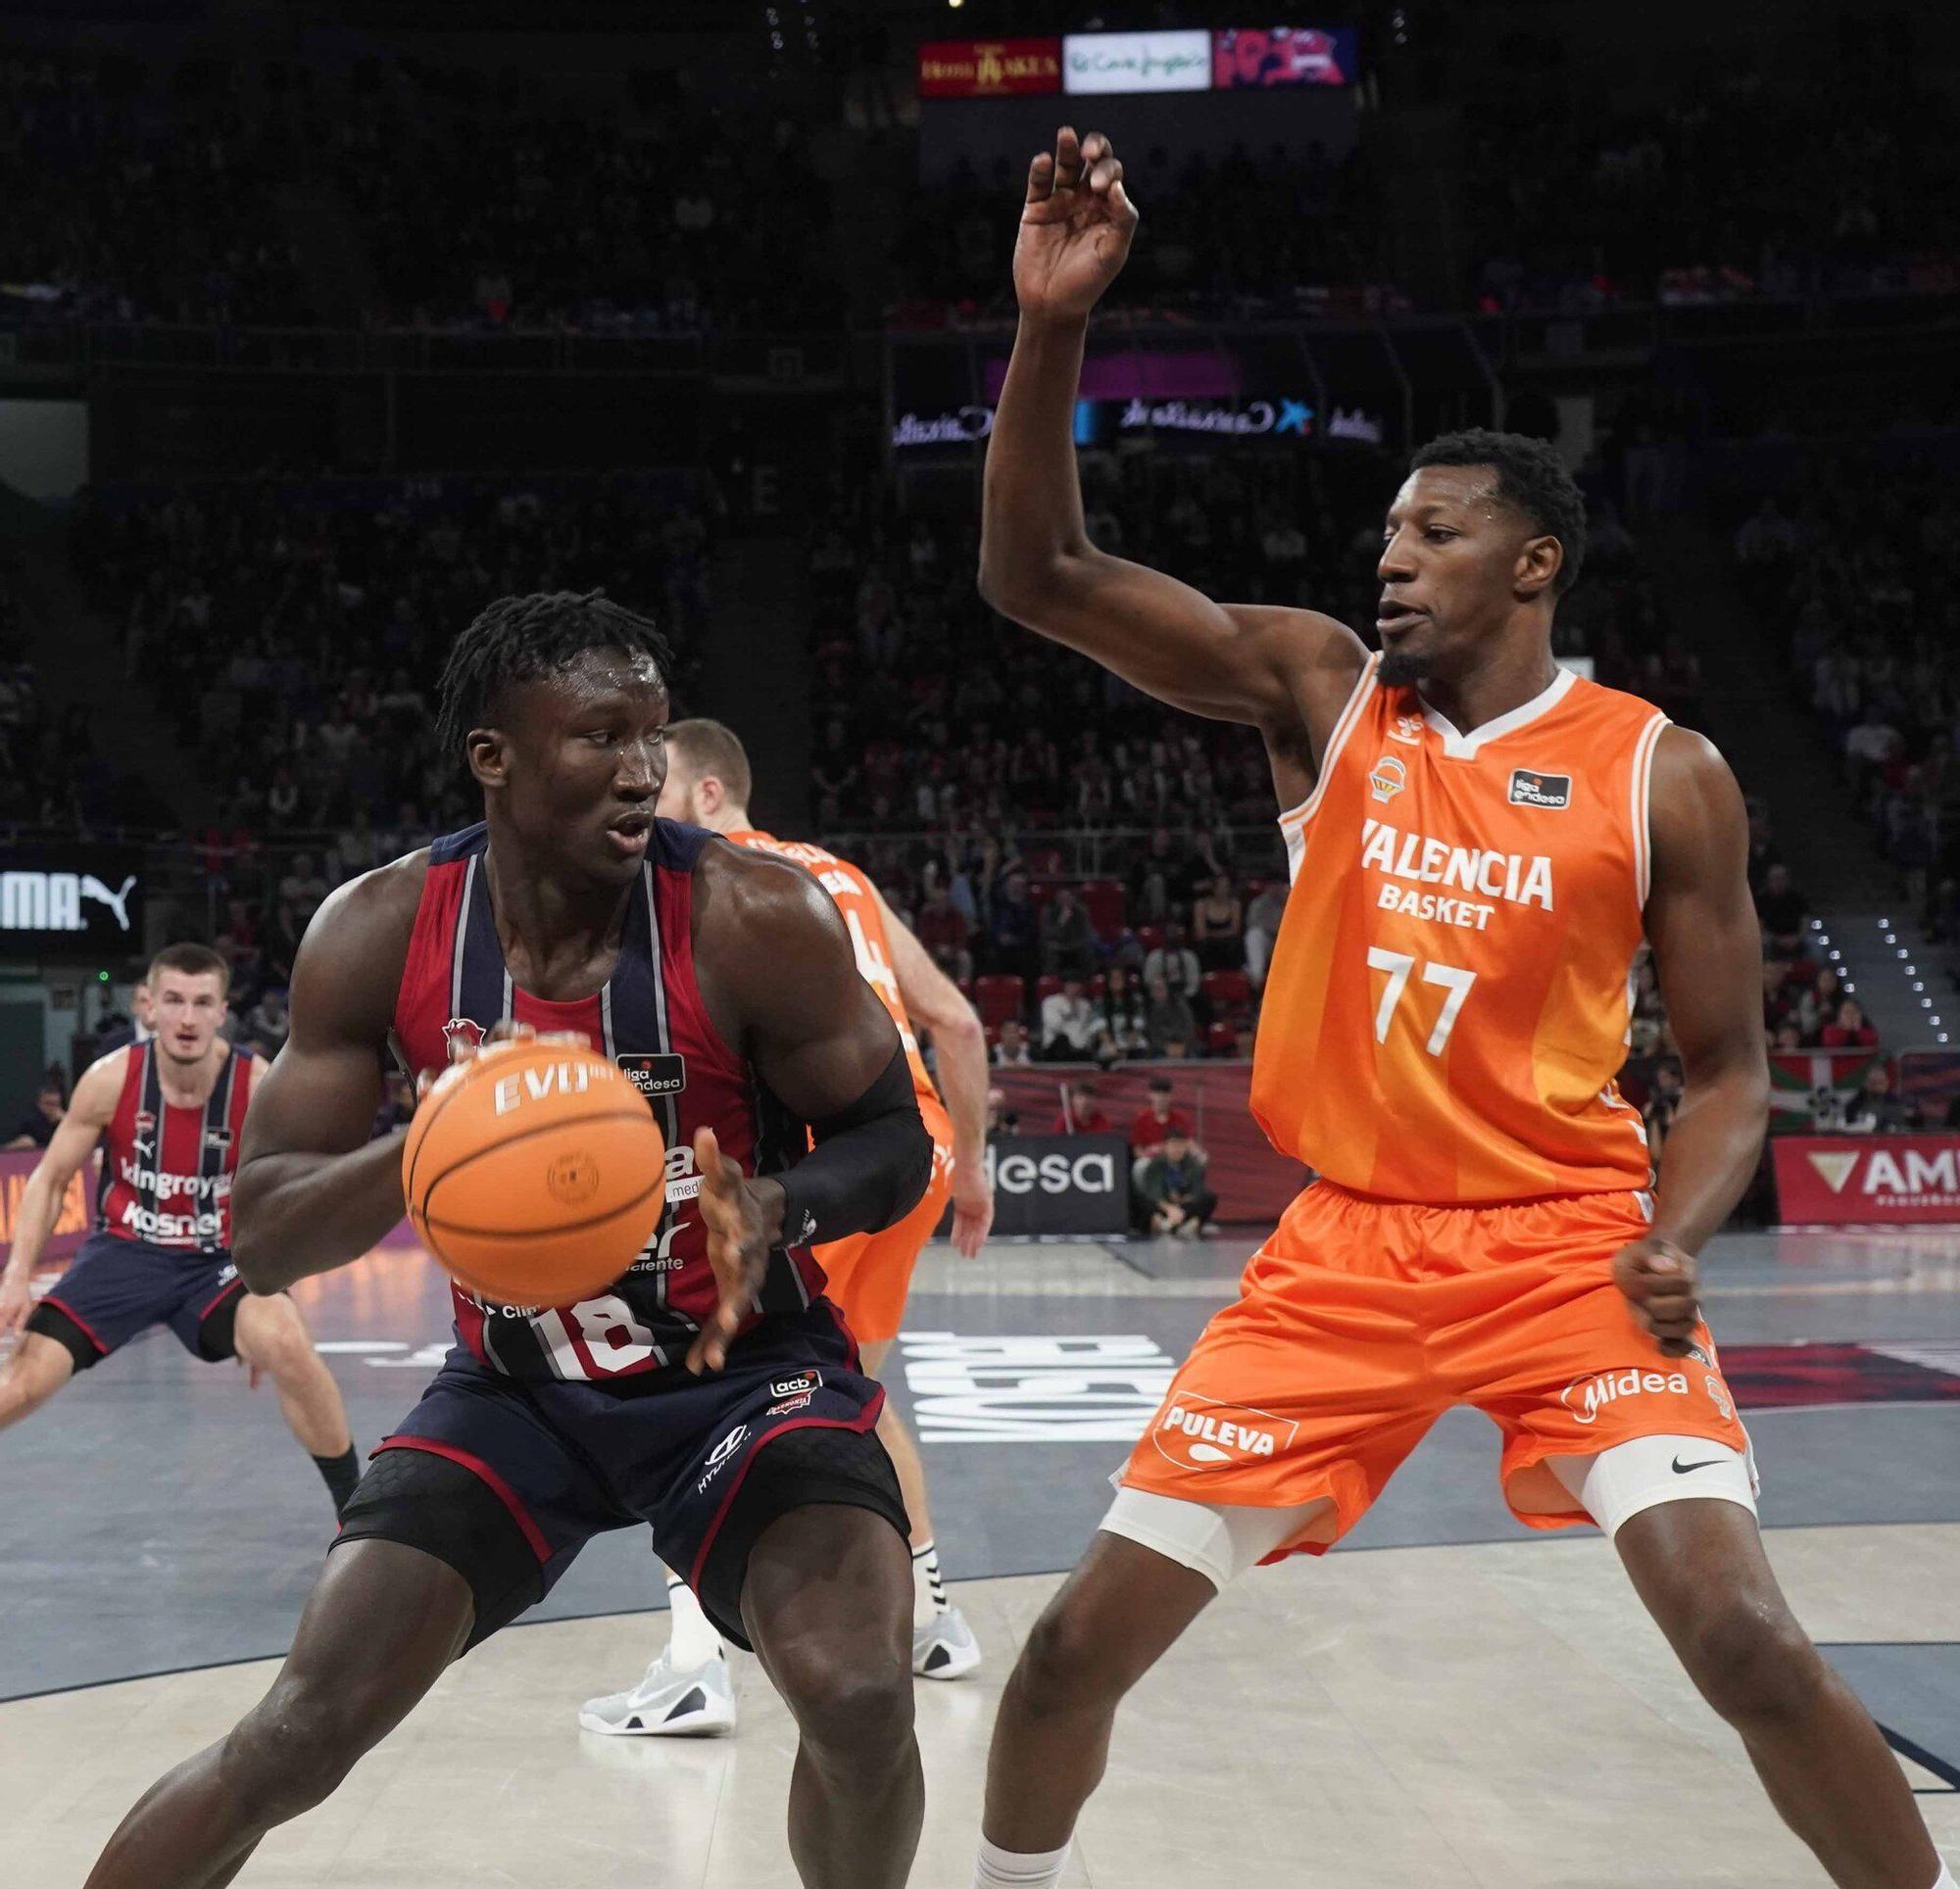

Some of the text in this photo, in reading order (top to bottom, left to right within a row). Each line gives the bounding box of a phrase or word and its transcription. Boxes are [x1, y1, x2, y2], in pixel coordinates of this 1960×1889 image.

[1378, 884, 1495, 931] BASKET
[1367, 946, 1477, 1057] 77
[623, 1068, 650, 1081] liga
[633, 1079, 680, 1090] ndesa
[672, 1179, 701, 1197] med
[1863, 1149, 1960, 1194] AM
[529, 1293, 656, 1380] 18
[776, 1378, 809, 1392] acb
[1572, 1369, 1689, 1424] Midea
[1163, 1406, 1275, 1457] PULEVA
